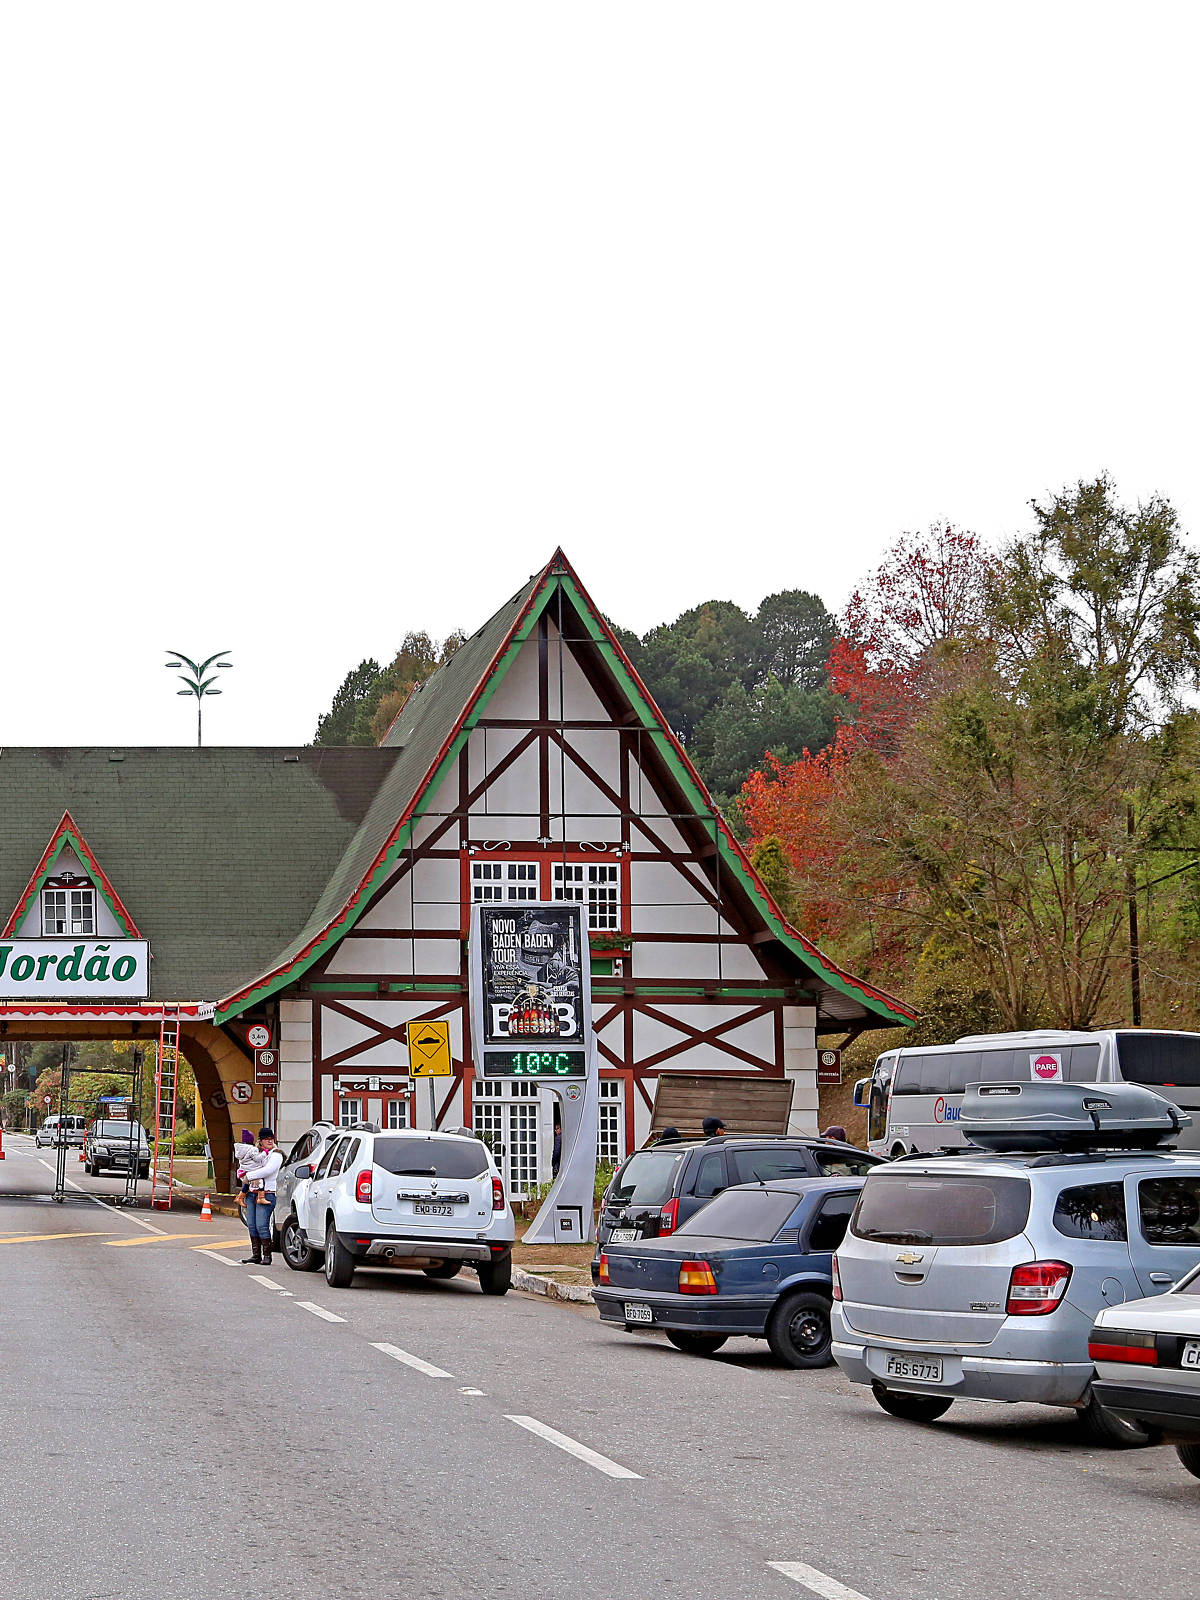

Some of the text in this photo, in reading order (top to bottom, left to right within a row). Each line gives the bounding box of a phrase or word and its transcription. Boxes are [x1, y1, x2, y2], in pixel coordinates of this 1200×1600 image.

[492, 919, 516, 934] NOVO
[492, 934, 554, 948] BADEN BADEN
[1035, 1063, 1057, 1071] PARE
